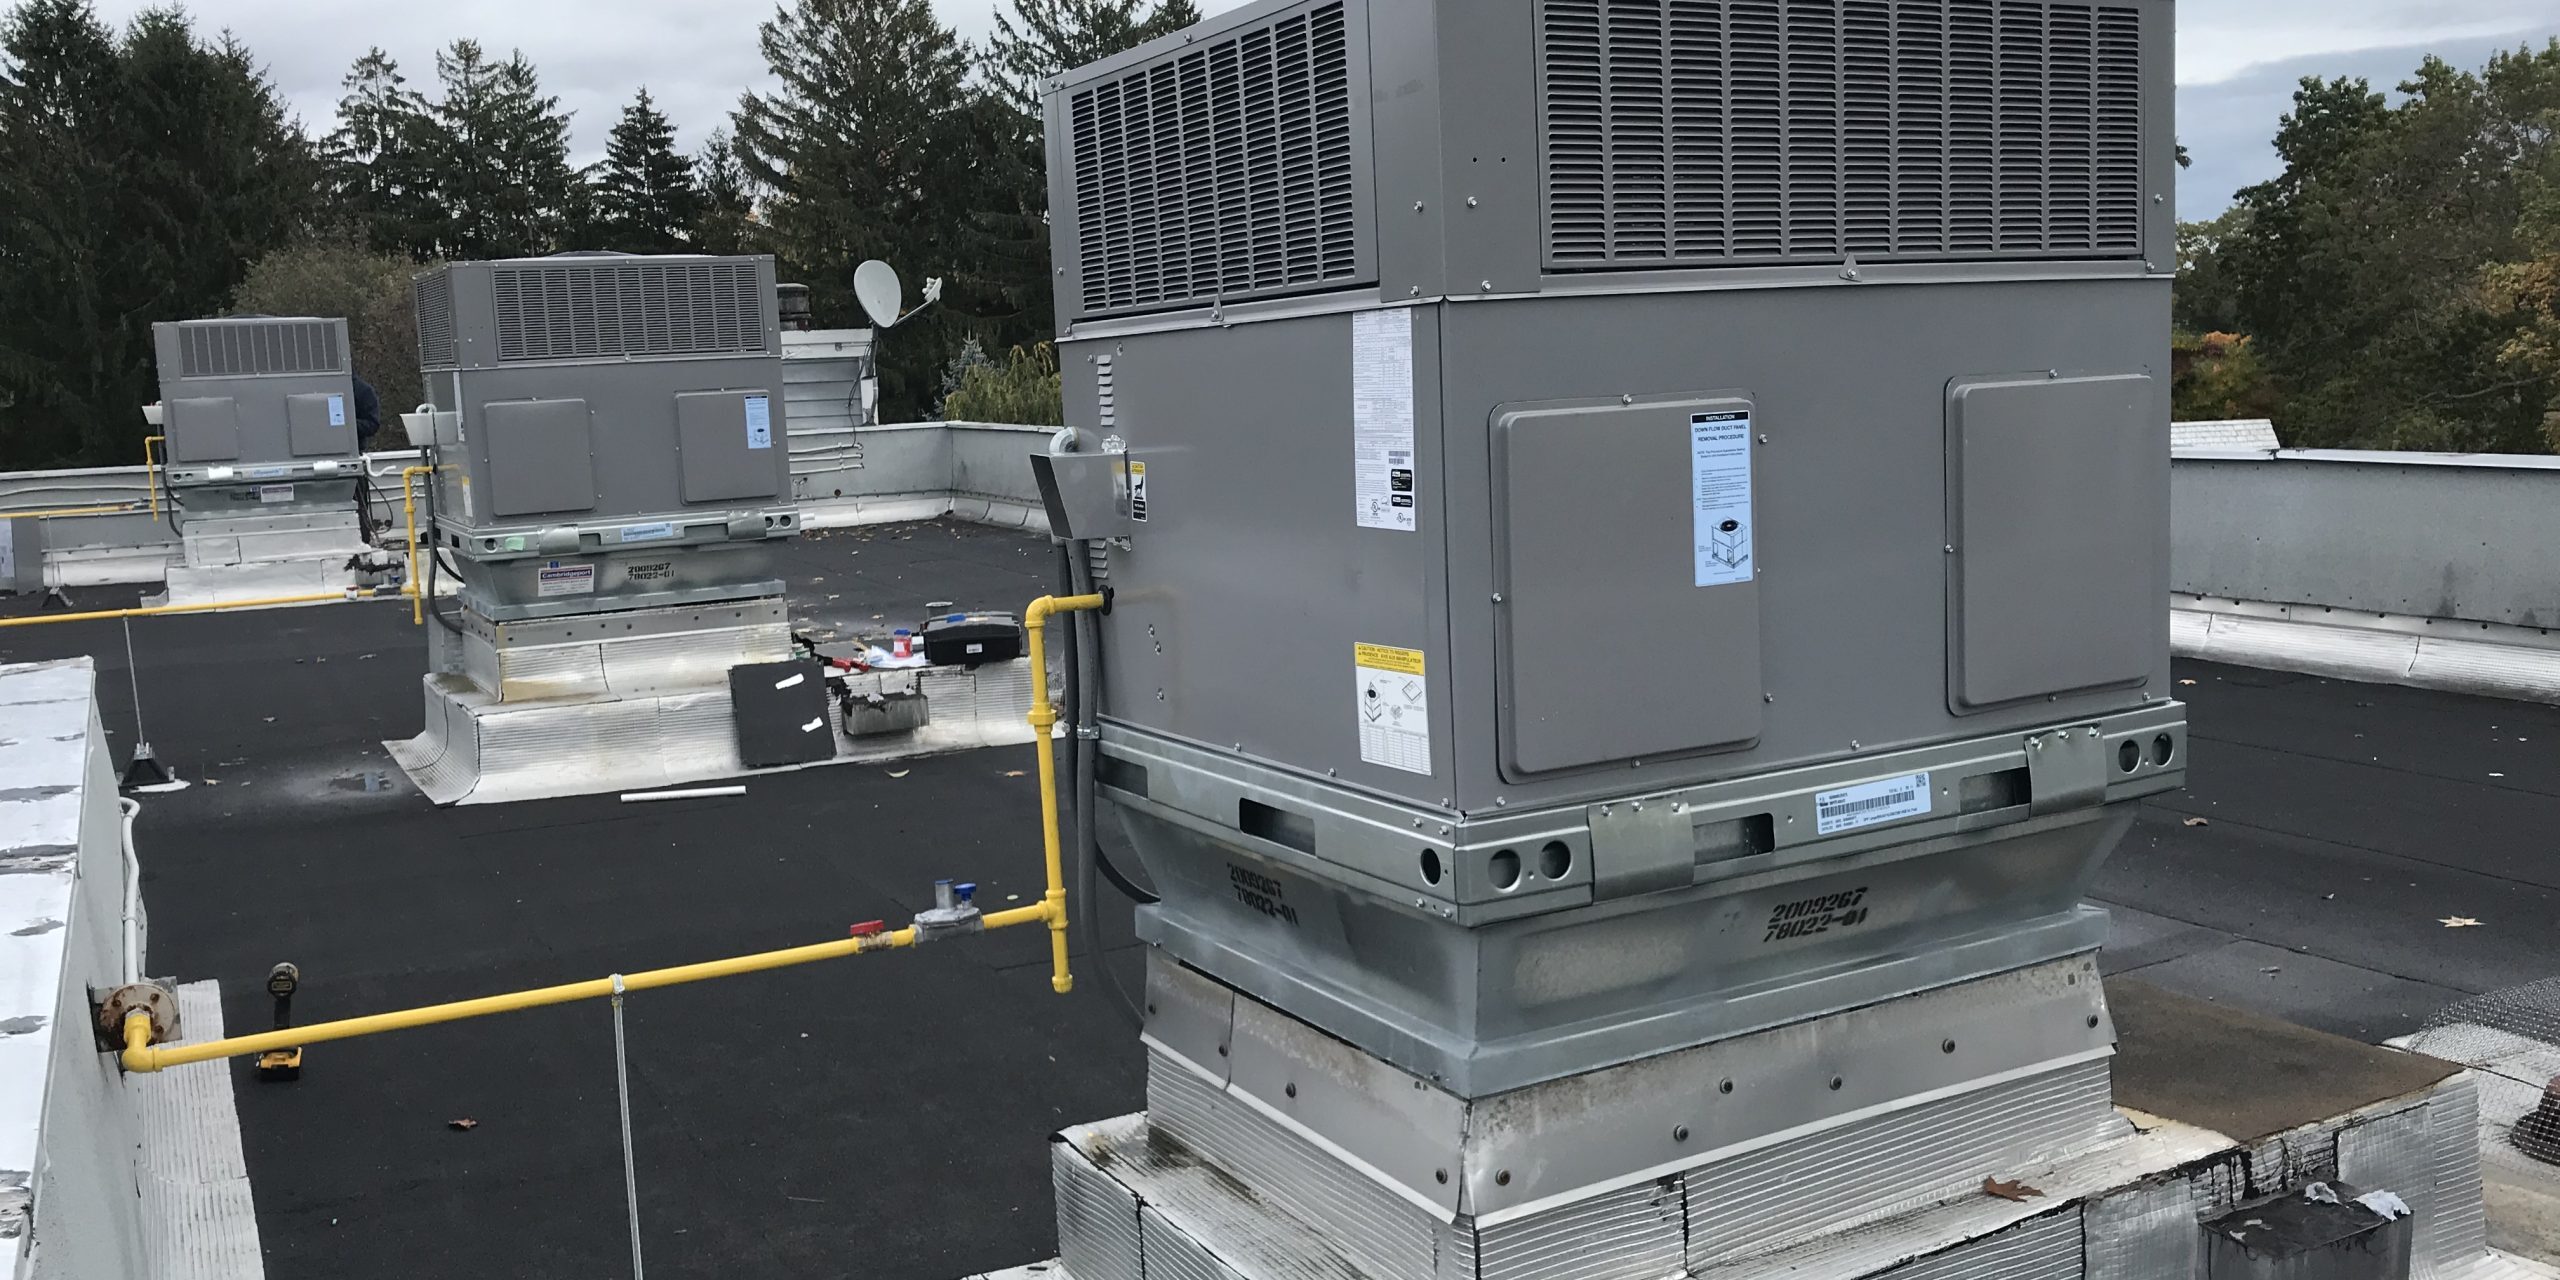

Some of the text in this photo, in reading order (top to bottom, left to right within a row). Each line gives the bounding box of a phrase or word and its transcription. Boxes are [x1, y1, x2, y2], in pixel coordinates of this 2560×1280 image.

[542, 570, 591, 578] Cambridgeport
[1768, 886, 1869, 923] 2009267
[1763, 907, 1869, 942] 78022-01
